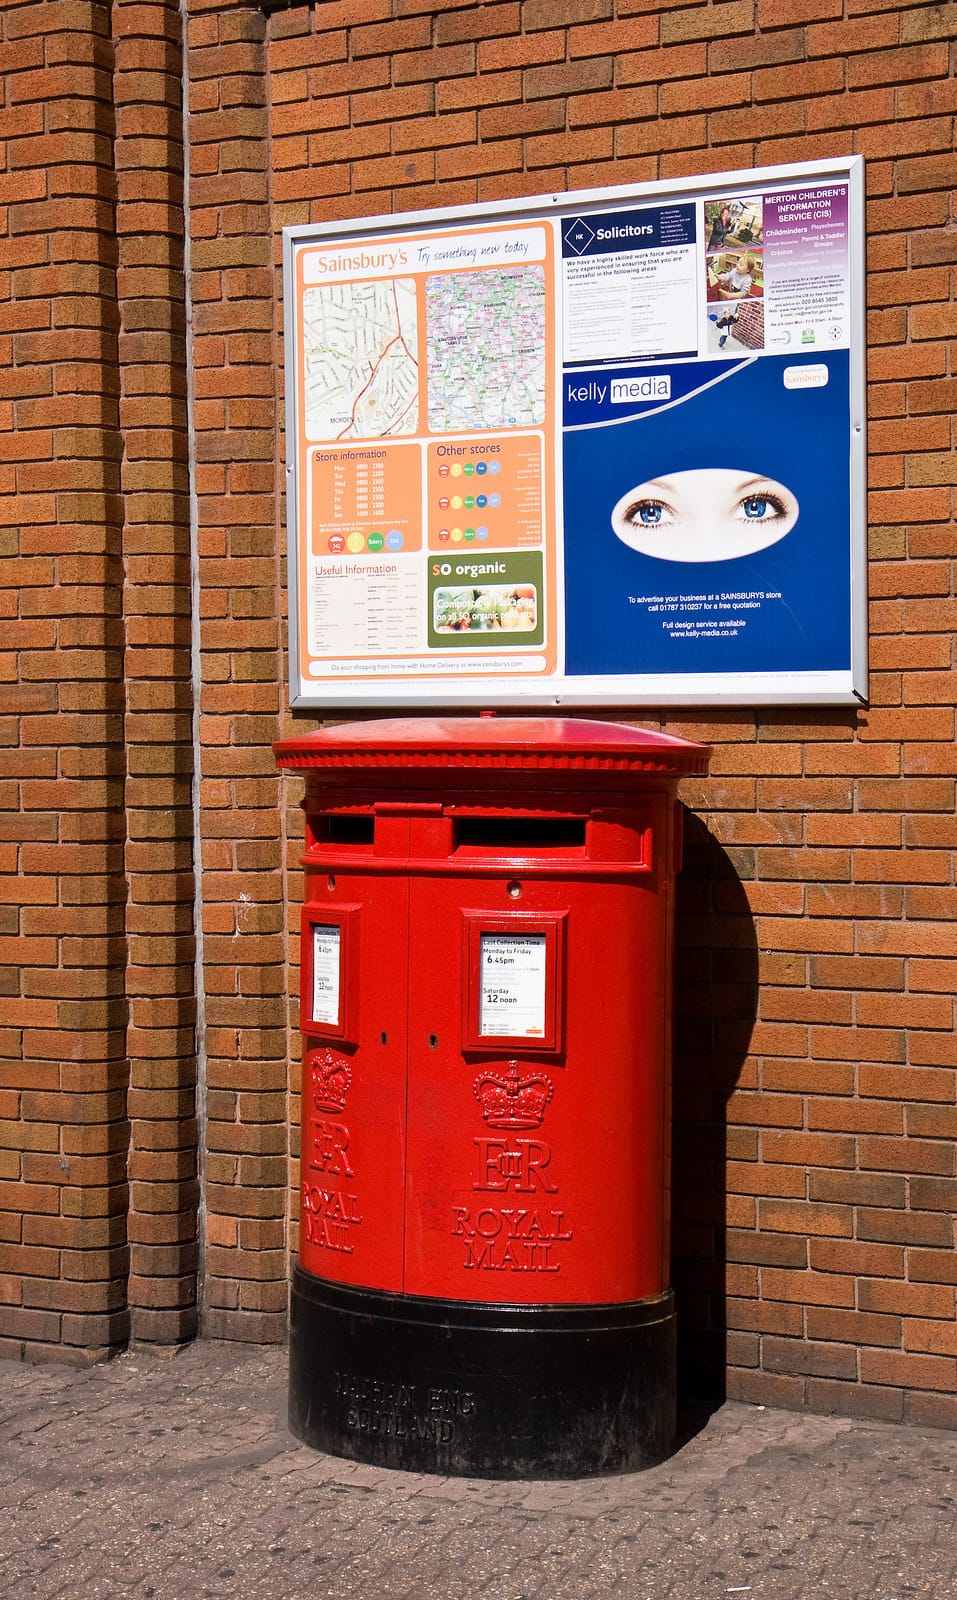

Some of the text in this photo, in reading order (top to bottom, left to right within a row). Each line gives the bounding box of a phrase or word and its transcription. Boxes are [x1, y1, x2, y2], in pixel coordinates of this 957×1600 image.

[765, 188, 846, 204] MERTON CHILDREN'S
[777, 200, 831, 213] INFORMATION
[779, 210, 832, 222] SERVICE (CIS)
[596, 225, 654, 240] Solicitors
[766, 227, 808, 236] Childminders
[416, 241, 529, 266] Try something new today
[318, 248, 408, 274] Sainsbury's
[580, 264, 614, 272] experienced
[622, 260, 646, 268] ensuring
[566, 271, 596, 280] successful
[614, 266, 640, 275] following
[568, 377, 668, 405] kelly media
[316, 450, 386, 462] Store information
[436, 444, 501, 456] Other stores
[315, 564, 396, 576] Useful Information
[432, 562, 506, 578] SO organic
[720, 592, 764, 600] SAINSBURYS
[660, 604, 678, 612] 01787
[732, 602, 760, 610] quotation
[458, 612, 470, 620] SO
[674, 621, 694, 630] design
[670, 629, 738, 638] www.kelly-media.co.uk
[354, 664, 376, 672] shopping
[438, 662, 460, 670] Delivery
[487, 994, 498, 1003] 12
[451, 1206, 574, 1240] ROYAL
[463, 1238, 560, 1272] MAIL
